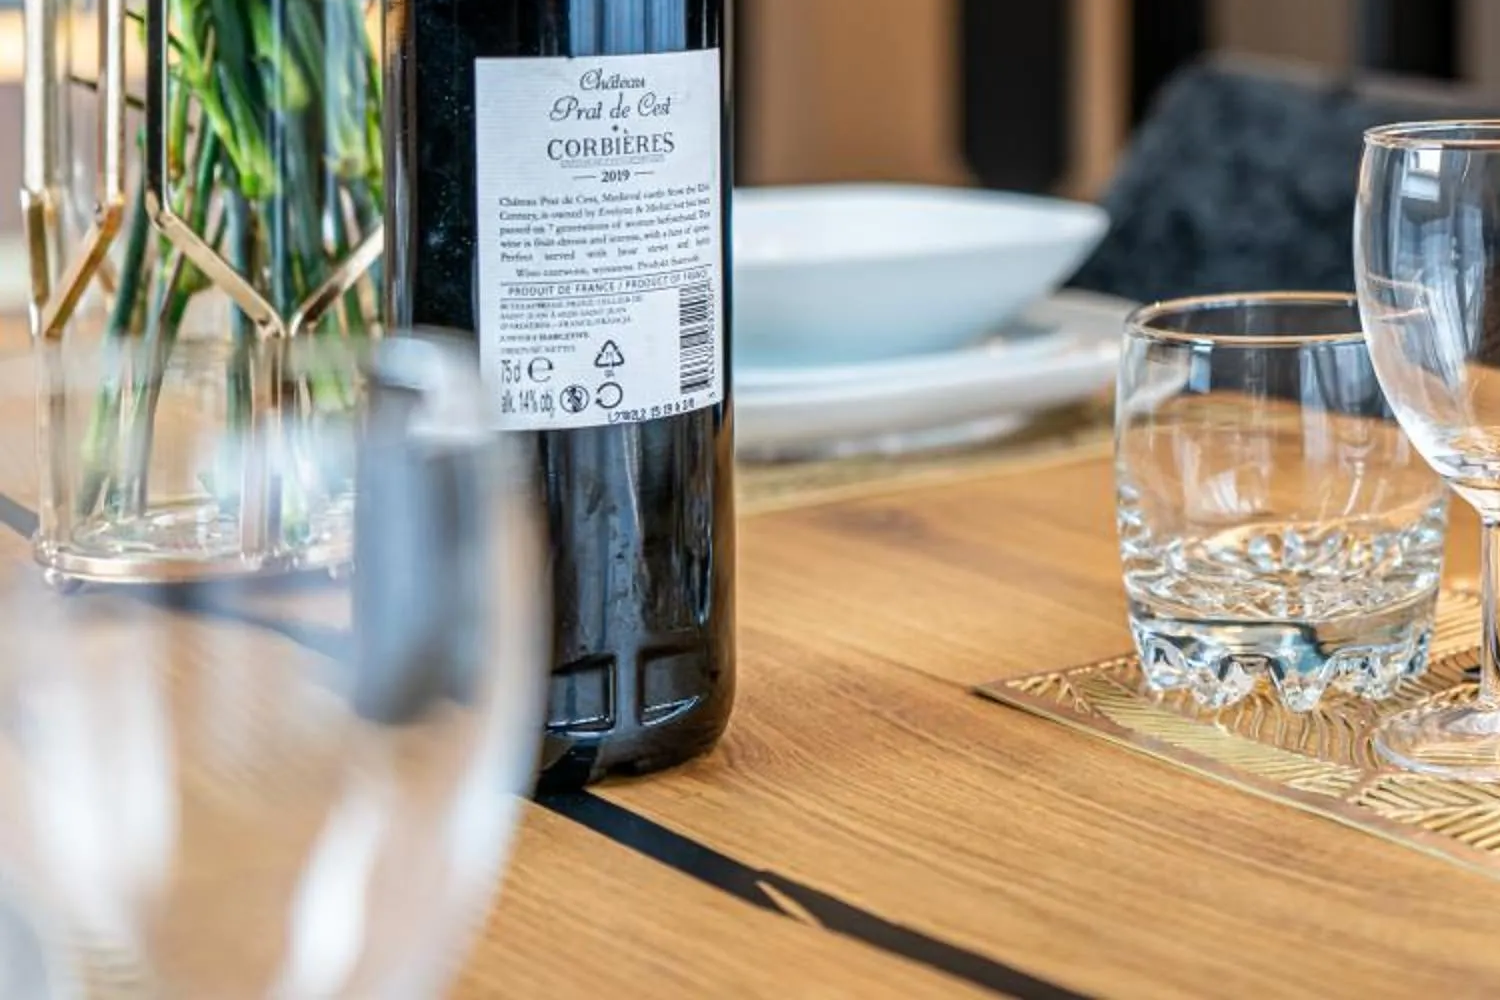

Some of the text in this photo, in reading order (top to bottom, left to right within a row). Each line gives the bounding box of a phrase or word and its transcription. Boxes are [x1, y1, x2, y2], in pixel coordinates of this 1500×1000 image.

[580, 68, 645, 90] Château
[549, 91, 671, 121] Prat de Cest
[547, 128, 675, 161] CORBIÈRES
[601, 169, 630, 182] 2019
[508, 285, 555, 296] PRODUIT
[557, 283, 572, 295] DE
[575, 280, 615, 293] FRANCE
[625, 274, 668, 289] PRODUCT
